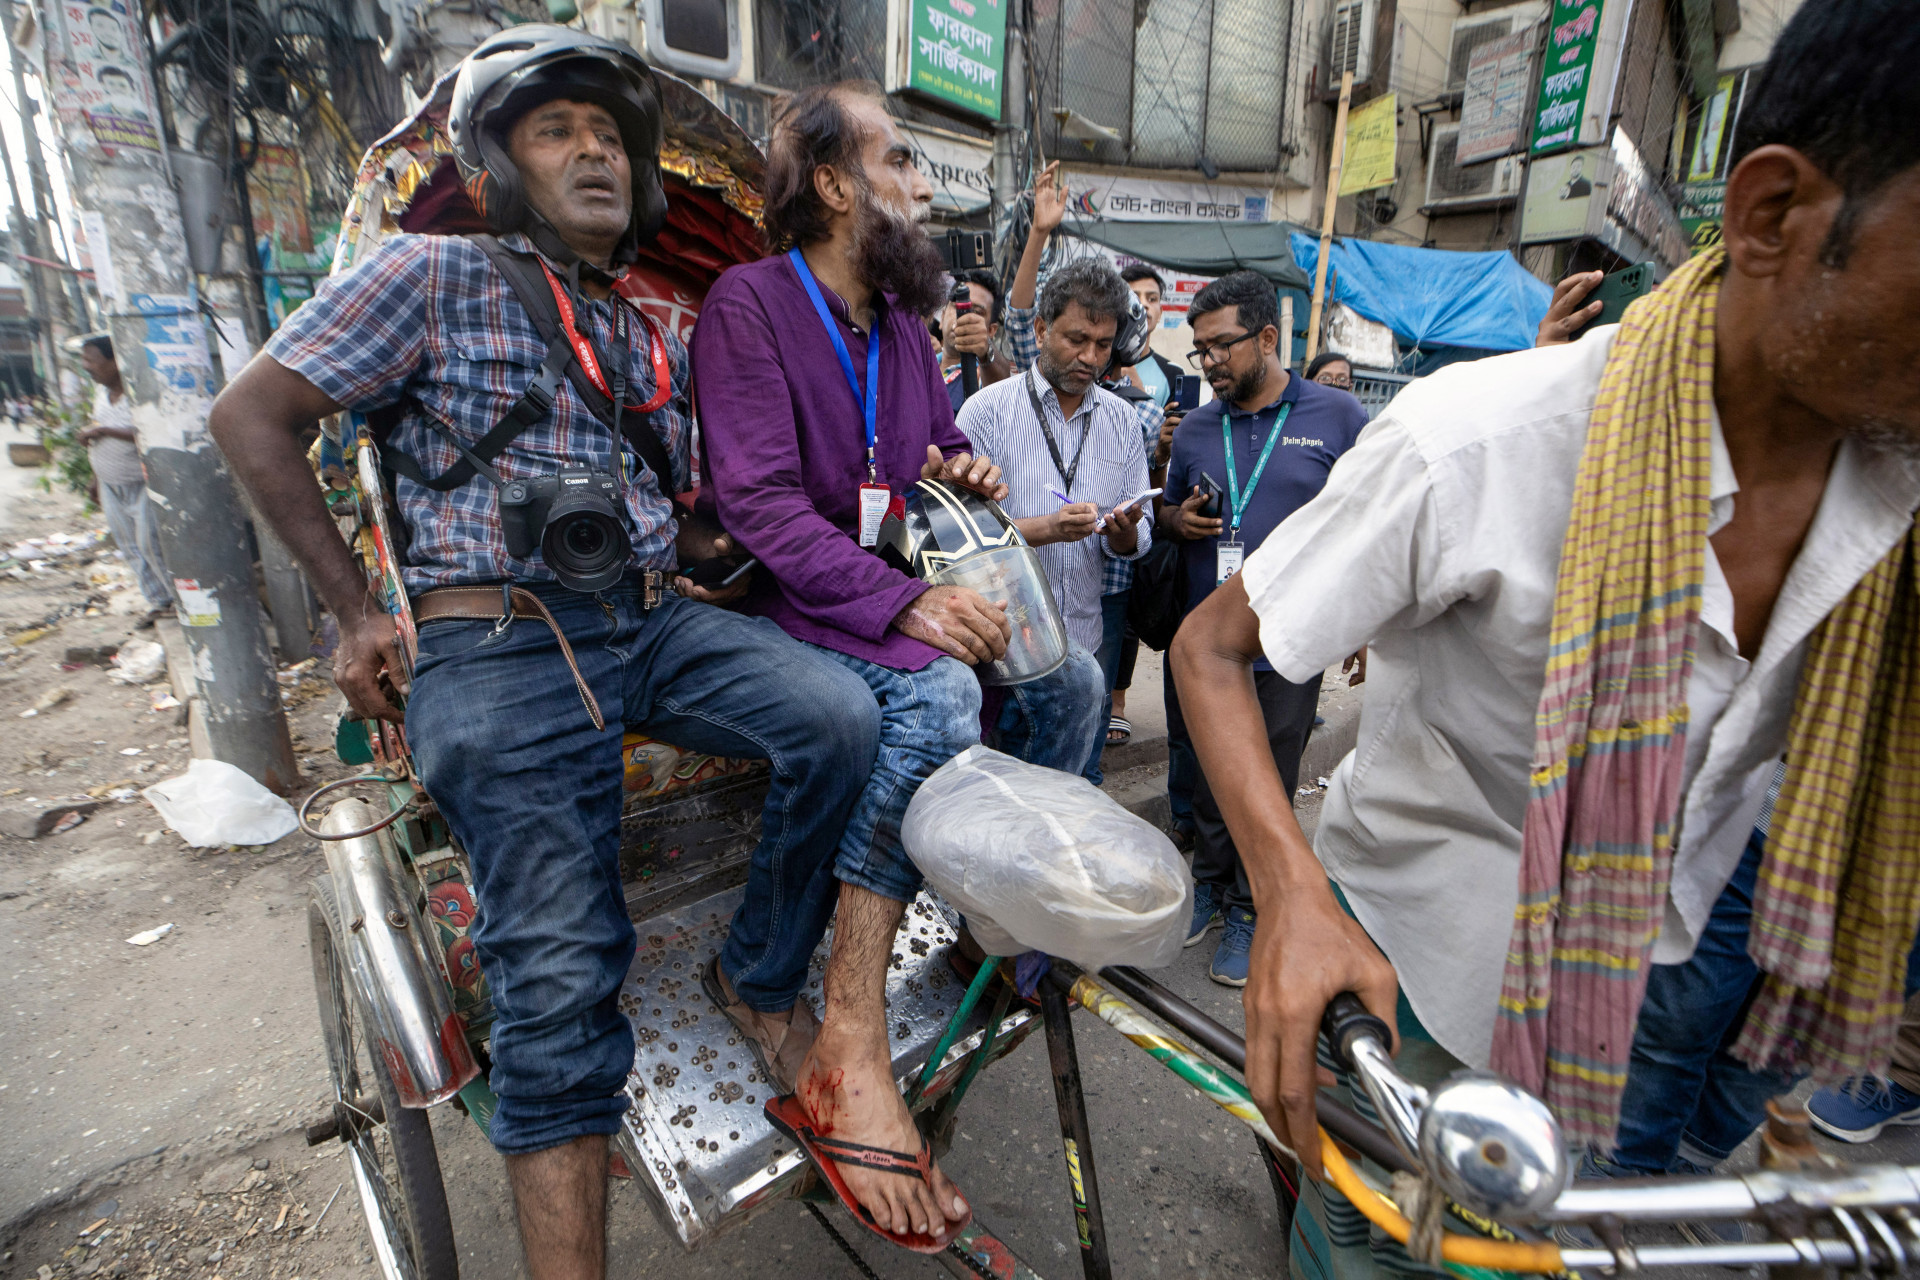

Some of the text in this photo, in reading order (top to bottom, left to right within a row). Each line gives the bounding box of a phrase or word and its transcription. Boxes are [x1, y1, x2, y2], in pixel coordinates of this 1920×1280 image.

[926, 5, 993, 58] ফারহানা
[918, 35, 997, 91] সার্জিক্যাল
[1545, 63, 1587, 97] ফারহানা
[912, 147, 992, 189] Express
[617, 303, 626, 338] Canon
[1282, 436, 1300, 446] Palm
